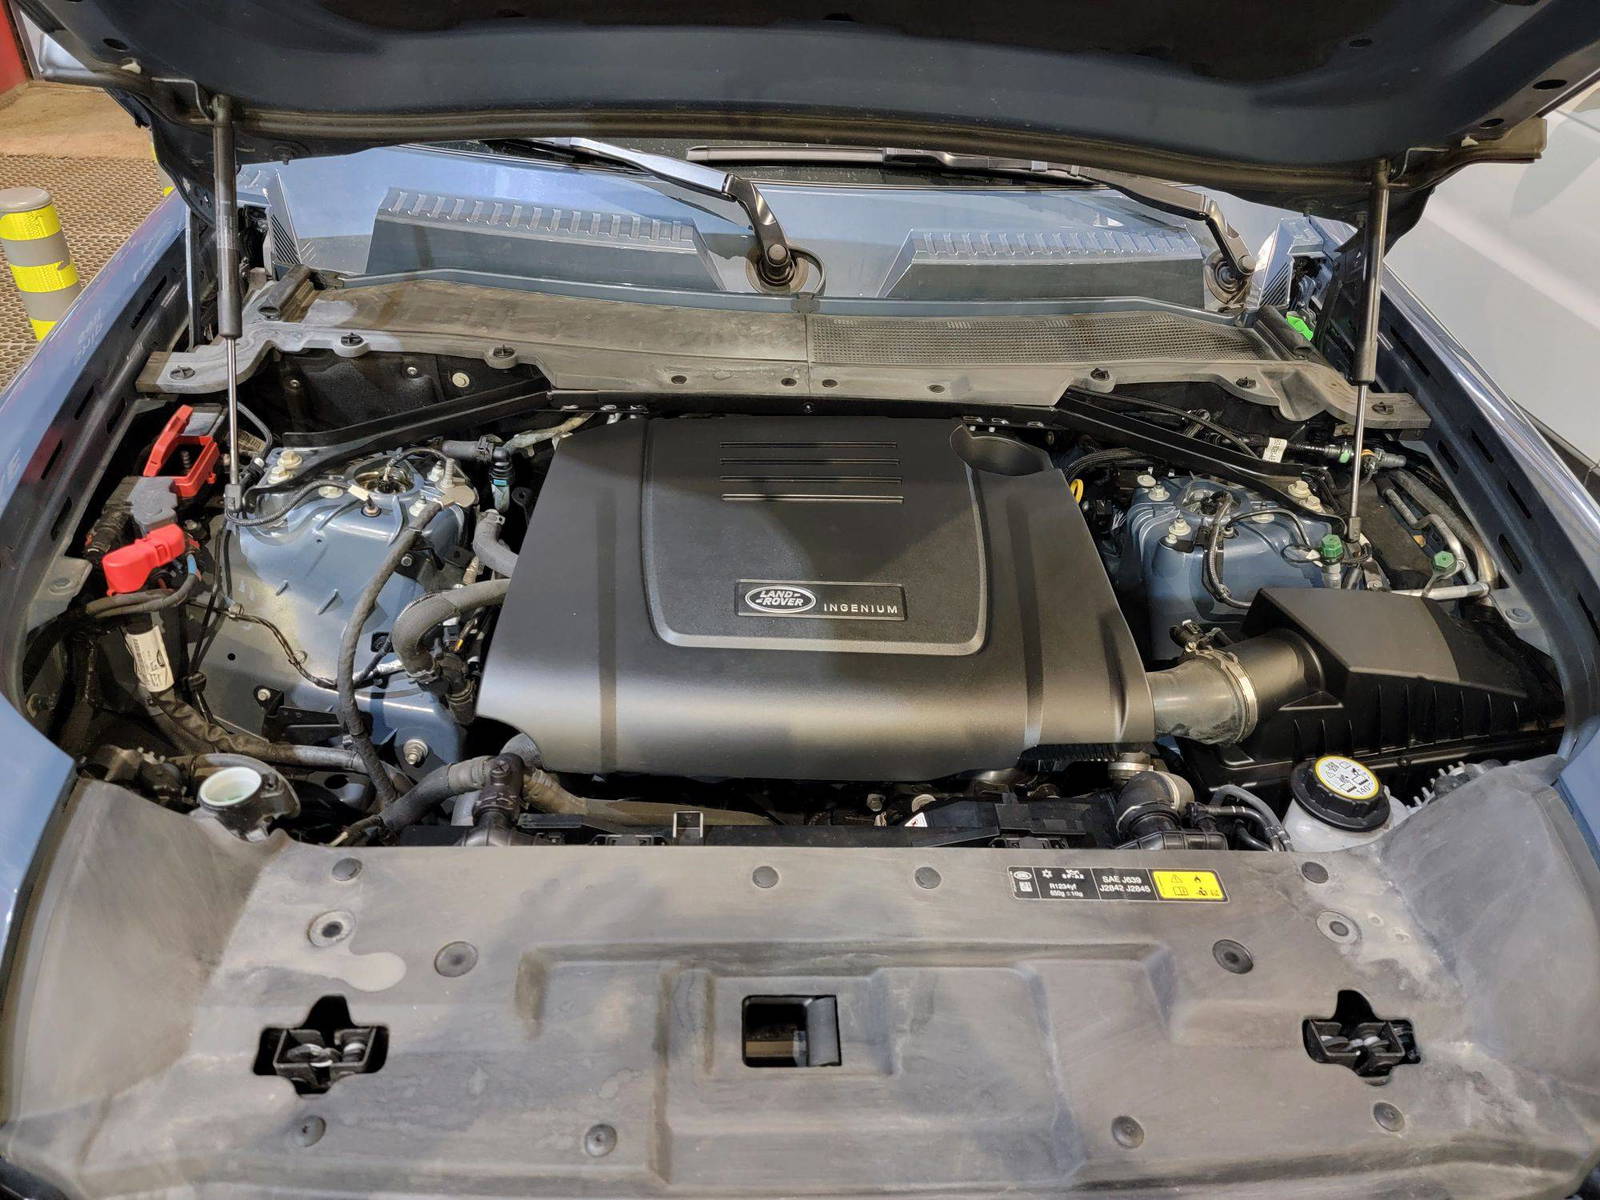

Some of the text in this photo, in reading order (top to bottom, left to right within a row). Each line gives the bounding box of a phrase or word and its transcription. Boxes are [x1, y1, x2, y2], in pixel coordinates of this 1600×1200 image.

[823, 603, 898, 614] INGENIUM
[1102, 875, 1142, 884] SAE J639
[1099, 884, 1125, 892] J2842
